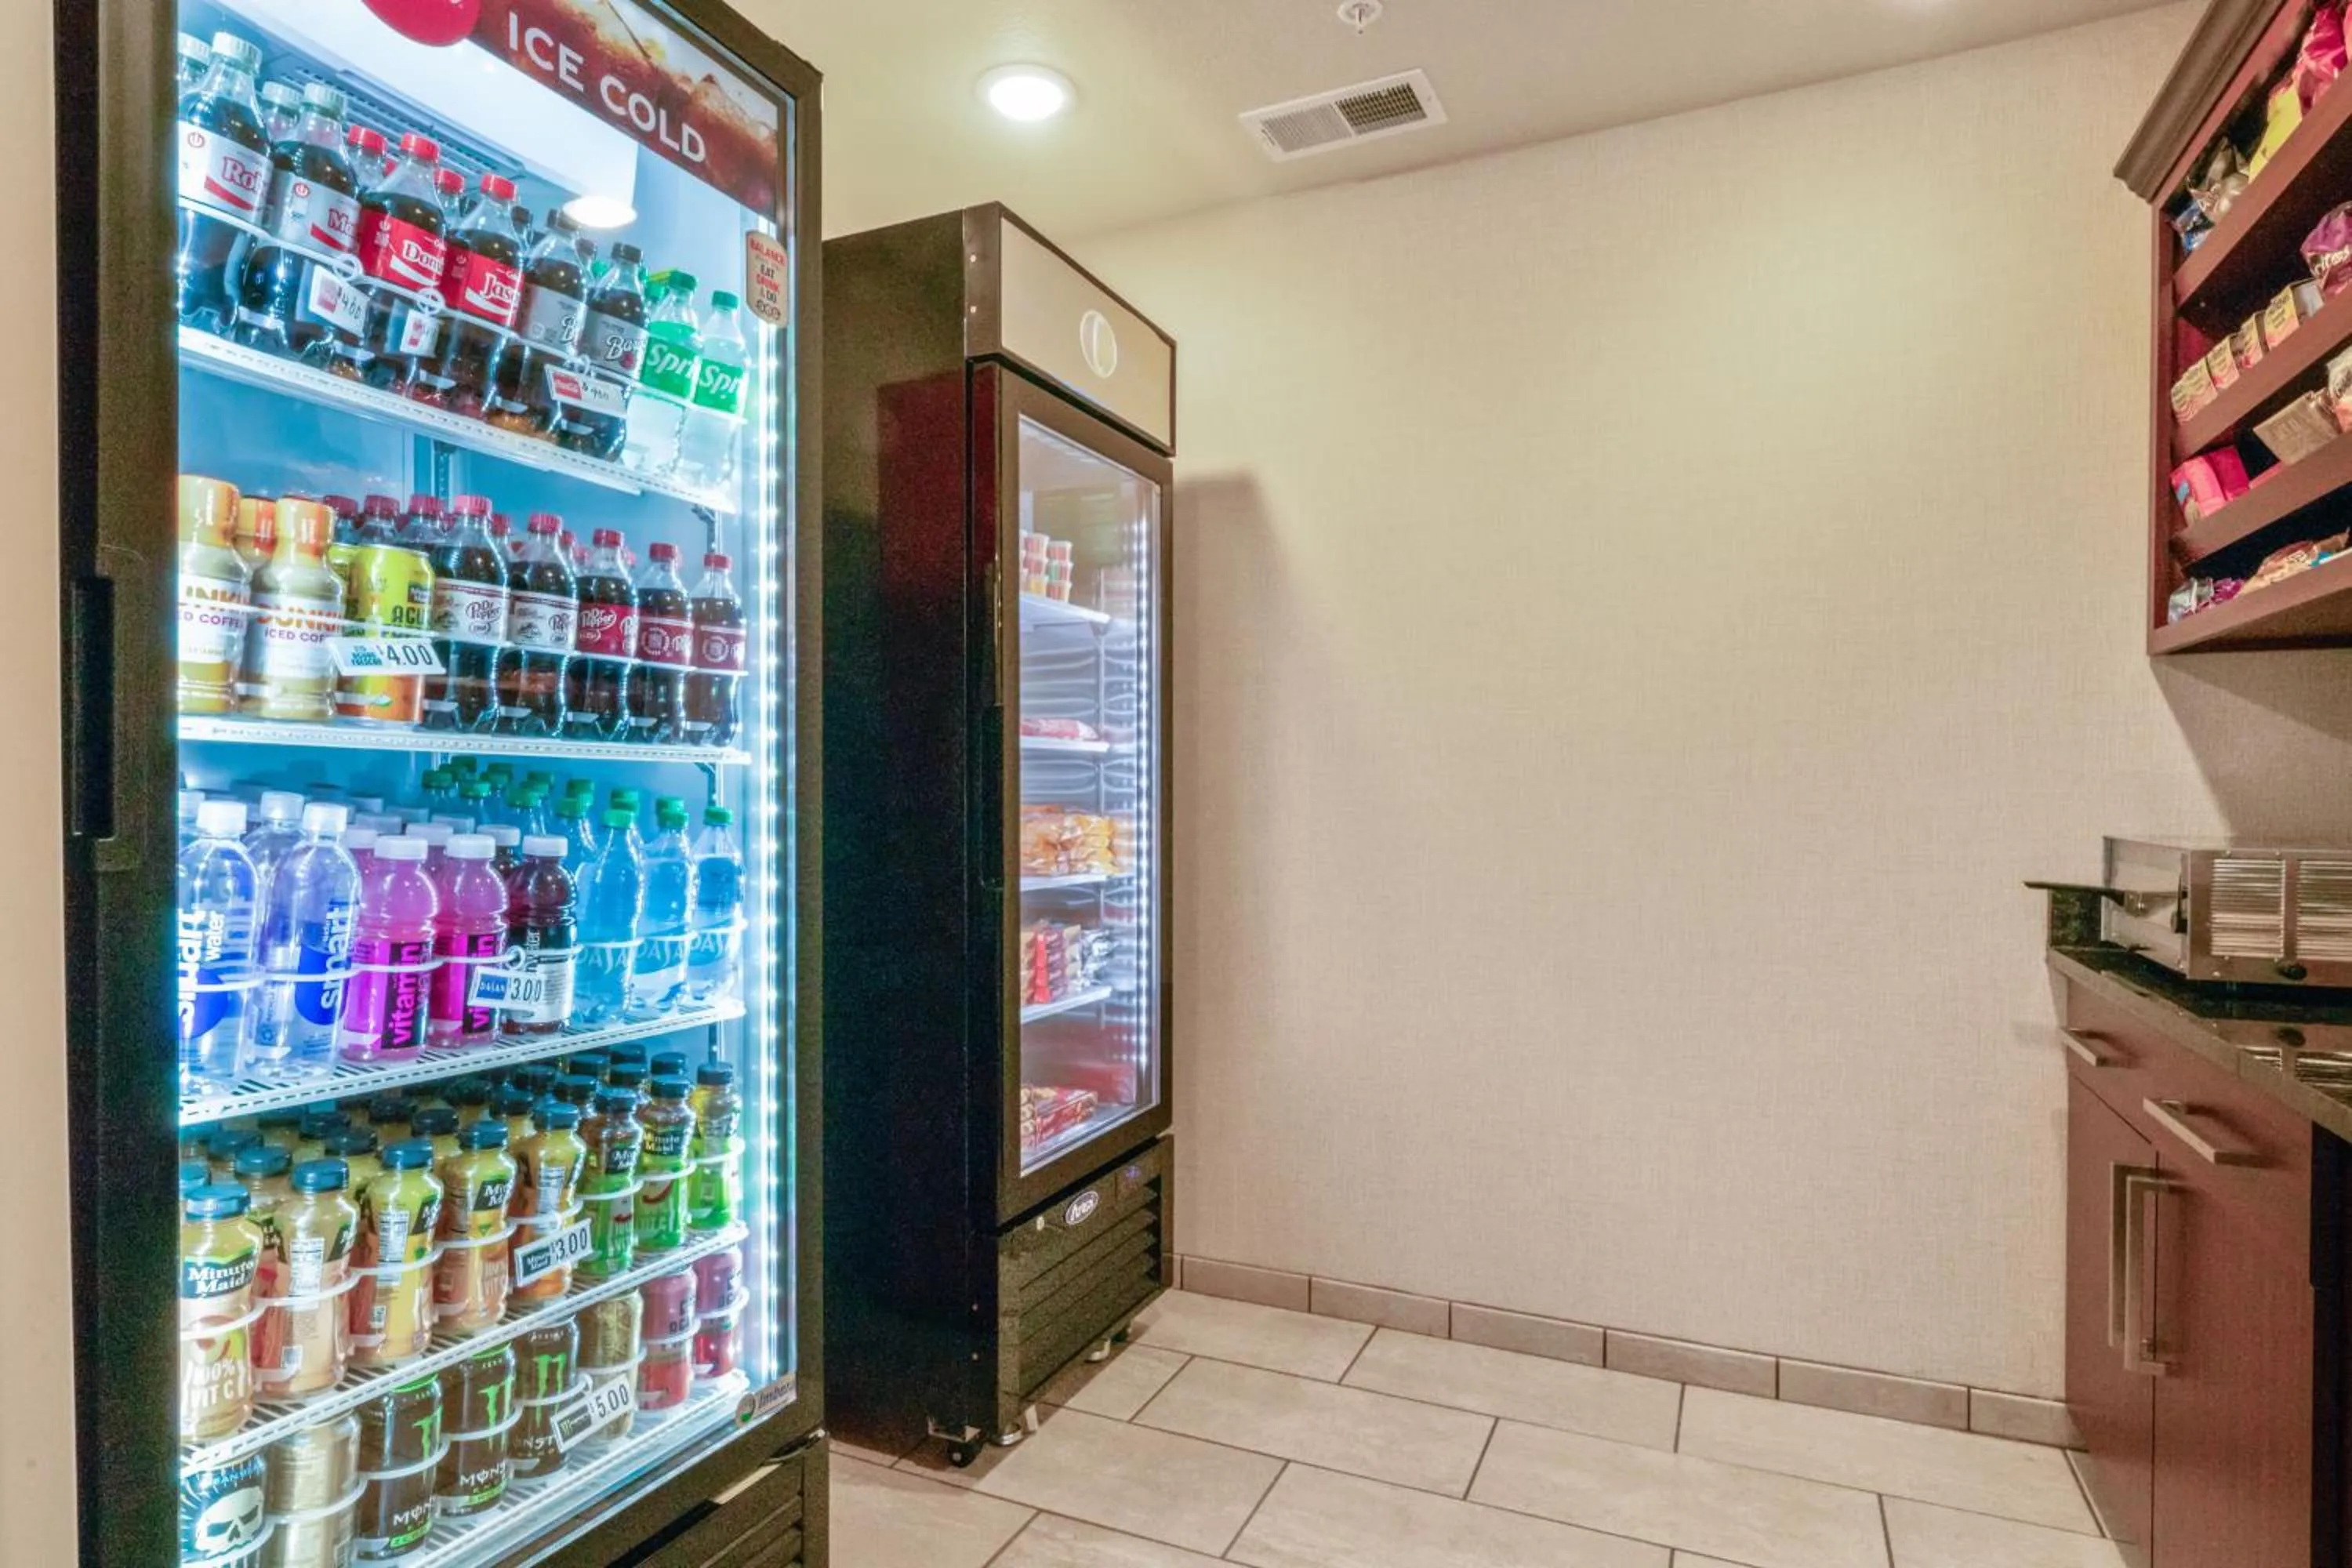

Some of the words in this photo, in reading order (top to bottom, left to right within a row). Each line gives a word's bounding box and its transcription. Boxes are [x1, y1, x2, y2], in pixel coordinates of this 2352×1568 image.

[509, 10, 584, 93] ICE
[600, 74, 706, 163] COLD
[264, 626, 296, 641] ICED
[205, 909, 225, 962] water
[321, 906, 350, 1010] smart
[187, 1259, 256, 1281] Minute
[194, 1274, 246, 1295] Maid
